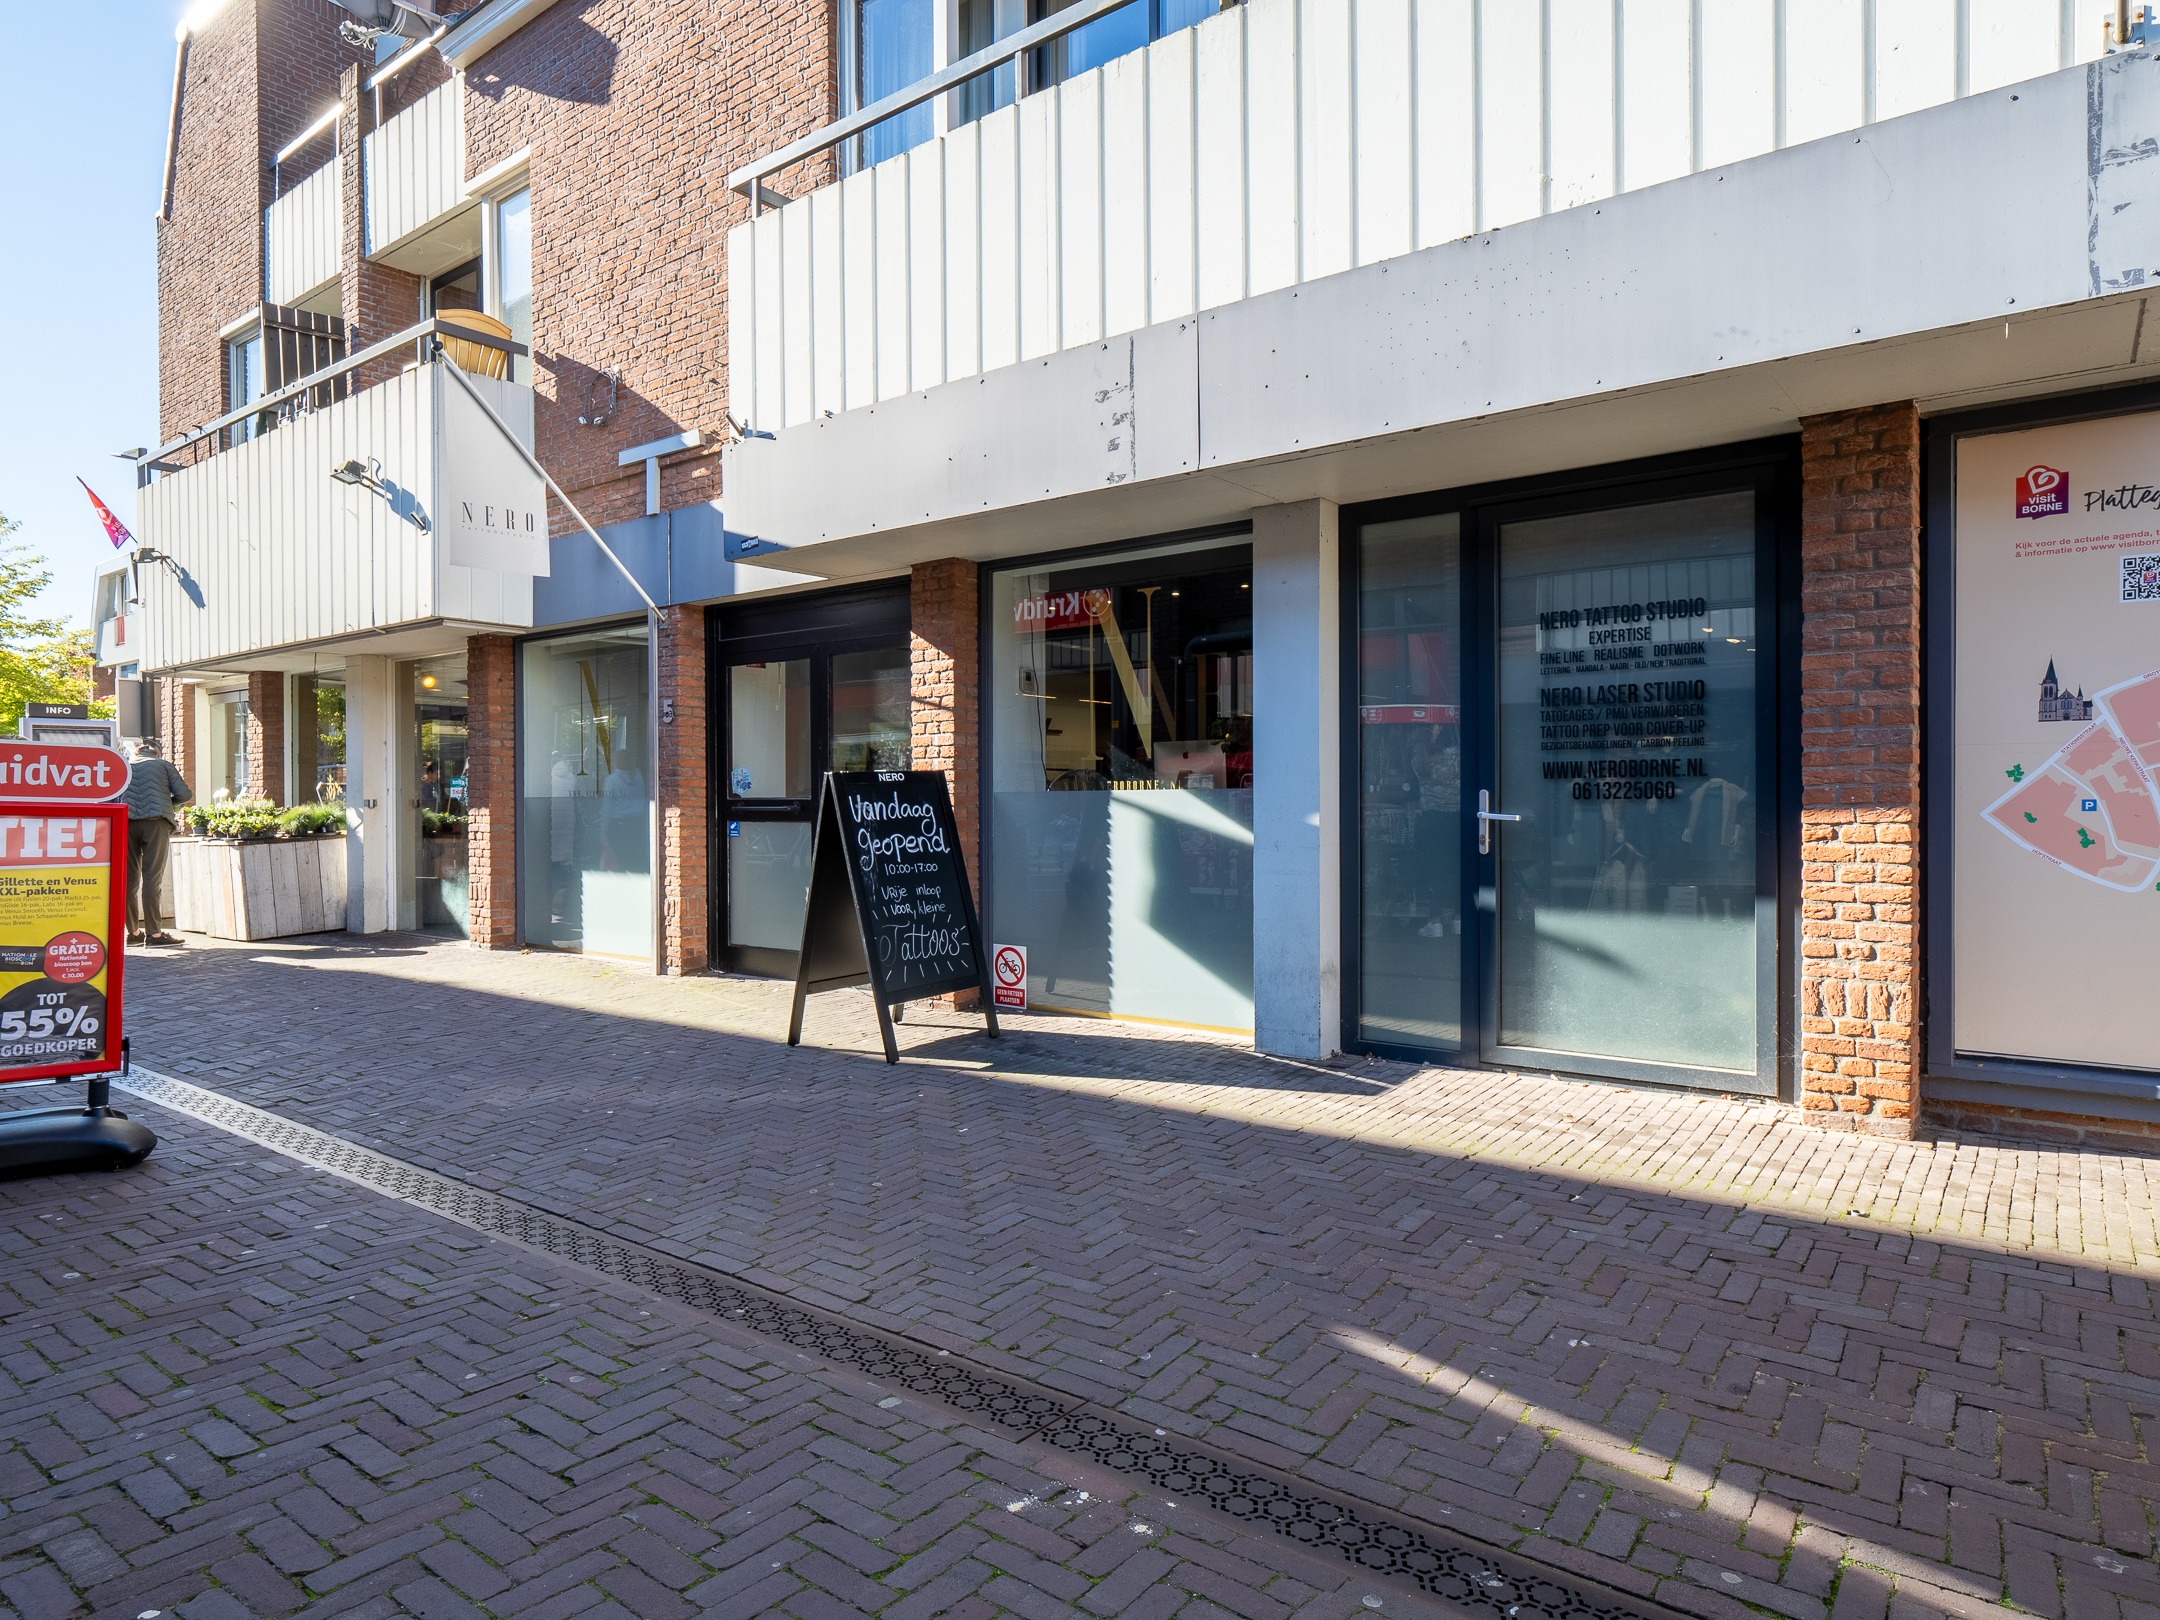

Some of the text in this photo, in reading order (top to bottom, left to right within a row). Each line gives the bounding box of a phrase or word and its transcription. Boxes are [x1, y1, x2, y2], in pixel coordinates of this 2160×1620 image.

[2028, 493, 2056, 503] visit
[2022, 502, 2063, 514] BORNE
[462, 501, 534, 532] NERO
[2074, 535, 2110, 544] actuele
[2113, 531, 2152, 540] agenda,
[2024, 547, 2073, 557] informatie
[1540, 597, 1705, 630] NERO TATTOO STUDIO
[1589, 626, 1651, 645] EXPERTISE
[1540, 641, 1706, 665] FINE LINE REALISME DOTWORK
[1540, 666, 1570, 676] LETTERING
[1576, 662, 1604, 673] MANDALA
[1609, 661, 1629, 671] MAORI
[1540, 679, 1705, 707] NERO LASER STUDIO
[46, 706, 71, 714] INFO
[1540, 708, 1593, 722] TATOEAGES
[1606, 707, 1628, 720] PMU
[1631, 703, 1704, 719] VERWIJDEREN
[1540, 720, 1706, 739] TATTOO PREP VOOR COVER-UP
[1540, 739, 1632, 751] GEZICHTSBEHANDELINGEN
[1640, 738, 1671, 748] CARBON
[1673, 737, 1705, 747] PEELING
[2061, 723, 2097, 754] STATIONSSTRAAT
[2119, 737, 2150, 783] NIEUWE KERKSTRAAT
[1542, 758, 1708, 779] WWW.NEROBORNE.NL
[878, 773, 905, 781] NERO
[1572, 780, 1675, 801] 0613225060
[2085, 801, 2094, 810] P
[848, 791, 936, 837] Vandaag
[858, 828, 950, 871] geopend
[2032, 849, 2062, 866] HOFSTRAAT
[885, 863, 938, 876] 10:00-17:00
[63, 877, 97, 885] Venus
[916, 884, 941, 898] inloop
[917, 900, 946, 915] kleine
[49, 944, 98, 955] GRATIS
[37, 993, 67, 1006] TOT
[1000, 996, 1020, 1004] PLAATSEN
[0, 1006, 99, 1041] 55%
[1, 1038, 97, 1057] GOEDKOPER
